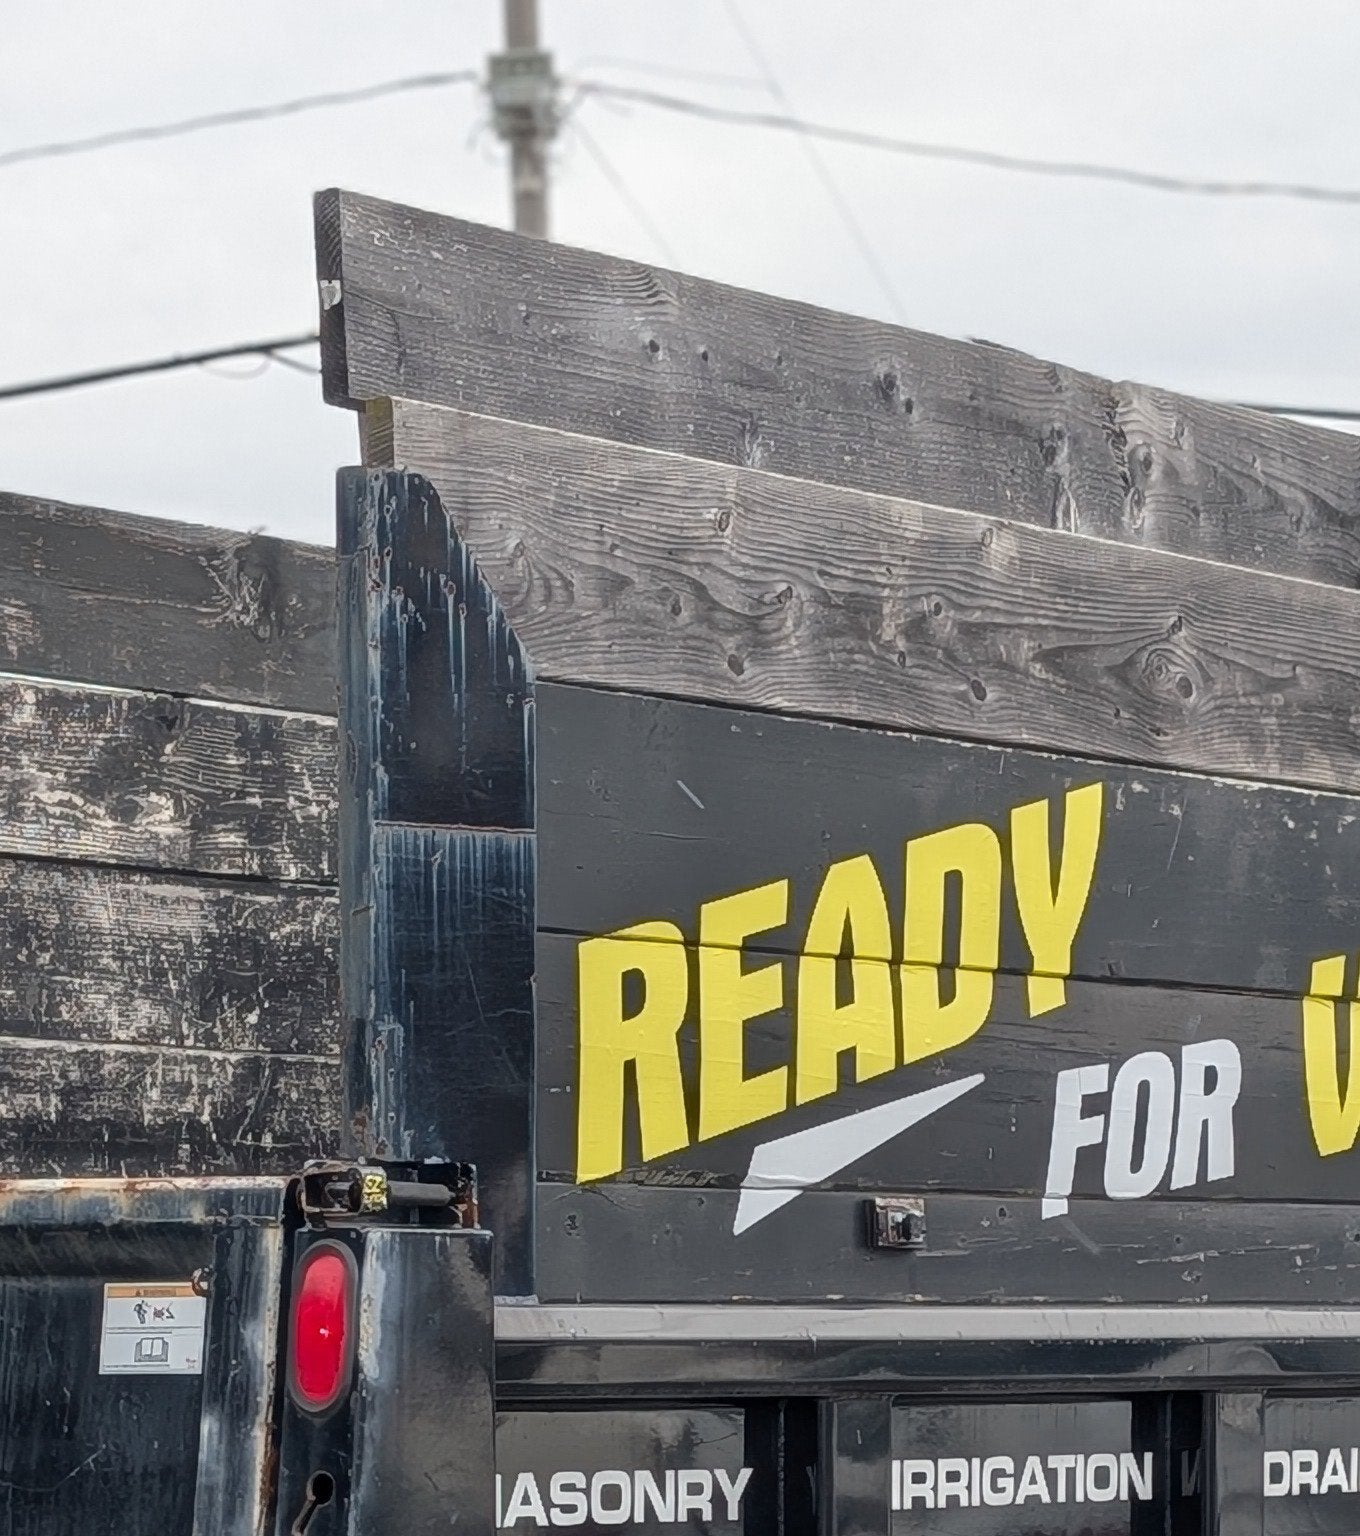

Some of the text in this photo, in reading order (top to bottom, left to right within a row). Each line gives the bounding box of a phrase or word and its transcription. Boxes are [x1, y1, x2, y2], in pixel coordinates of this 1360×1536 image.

[576, 782, 1103, 1184] READY
[1041, 1037, 1243, 1221] FOR
[495, 1467, 754, 1529] ASONRY
[891, 1451, 1153, 1511] IRRIGATION
